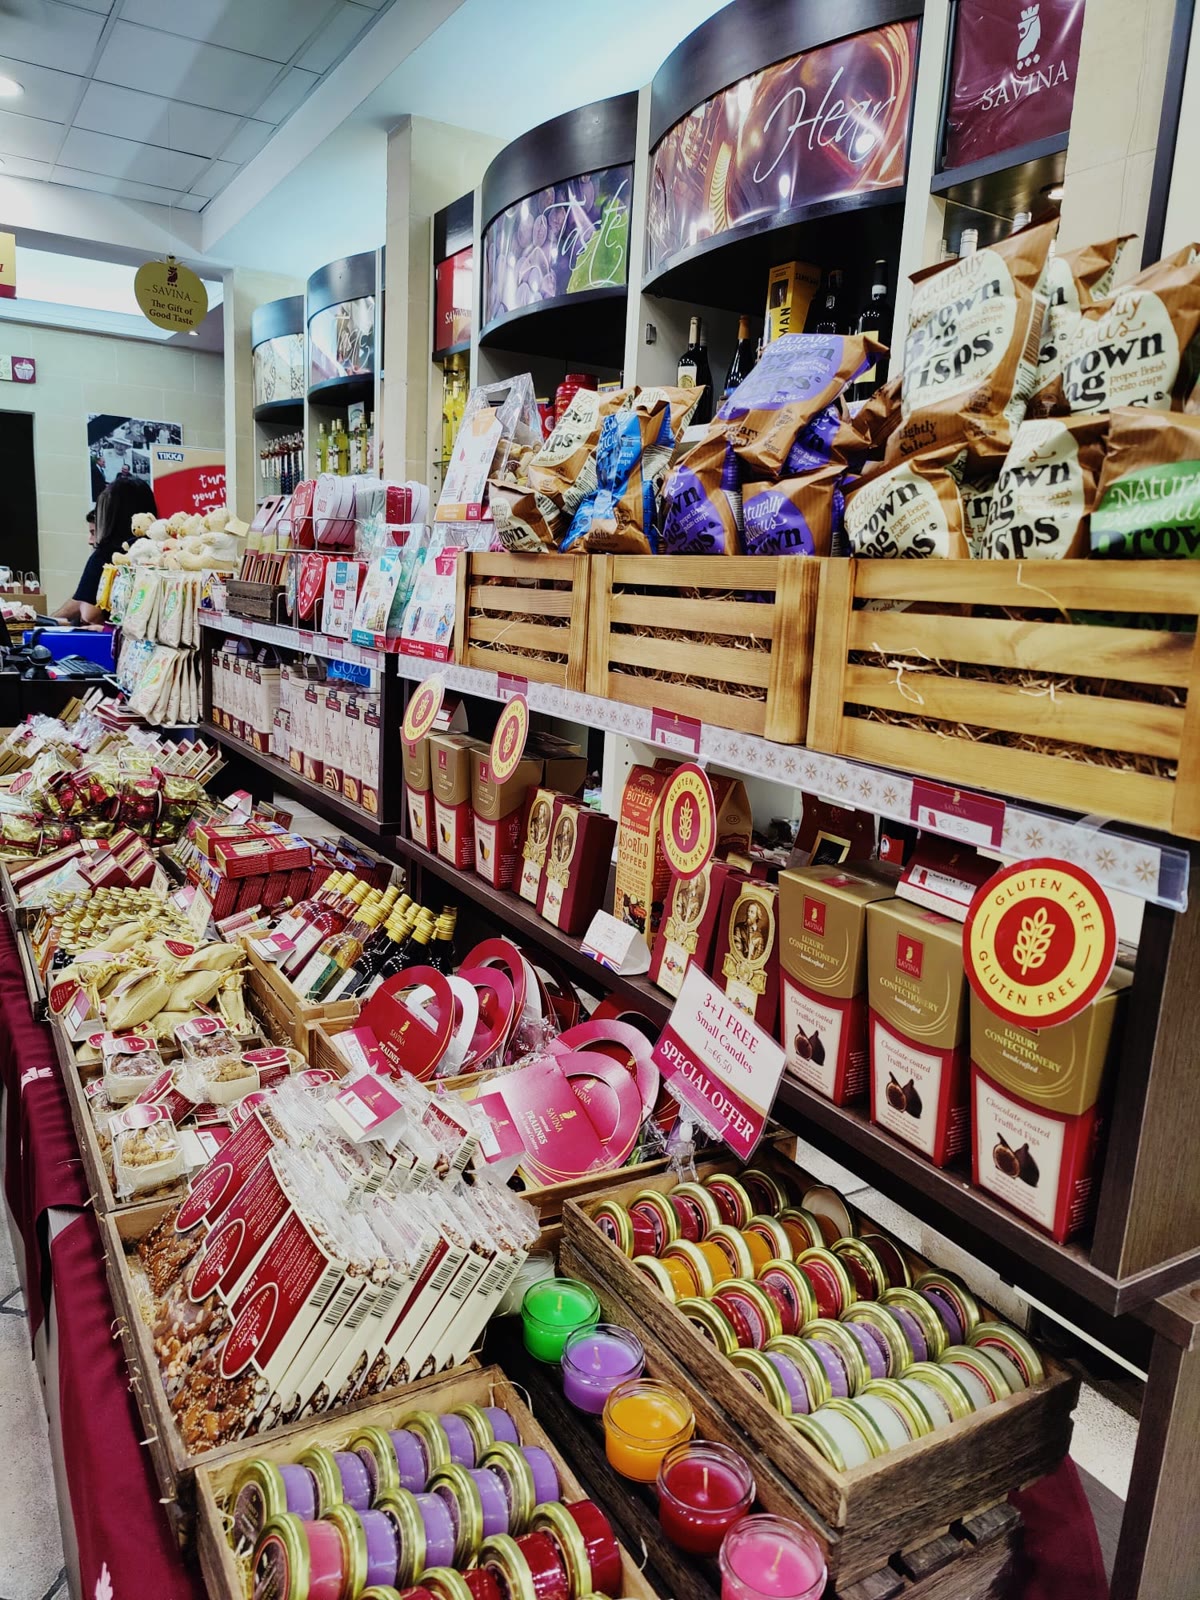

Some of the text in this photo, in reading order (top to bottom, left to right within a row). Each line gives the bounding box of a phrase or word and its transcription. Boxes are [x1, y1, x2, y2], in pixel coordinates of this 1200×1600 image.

[981, 60, 1069, 111] SAVINA
[753, 66, 896, 184] Hear
[542, 179, 628, 288] Taste
[152, 284, 191, 302] SAVINA
[149, 308, 194, 326] Good Taste
[151, 299, 193, 316] The Gift of
[1064, 332, 1166, 386] rown
[1110, 370, 1139, 386] proper
[192, 490, 217, 507] your
[855, 483, 923, 548] rown
[889, 515, 907, 534] proper
[626, 790, 654, 808] BUTLER
[669, 776, 707, 809] GLUTEN FREE
[619, 851, 648, 870] TOFFEES
[666, 833, 706, 868] GLUTEN FREE
[995, 876, 1095, 933] GLUTEN FREE
[804, 919, 823, 933] SAVINA
[788, 937, 840, 966] CONFECTIONERY
[801, 935, 825, 951] LUXURY
[897, 958, 920, 975] SAVINA
[979, 950, 1077, 1007] GLUTEN FREE
[879, 976, 939, 1013] CONFECTIONERY
[894, 975, 920, 994] LUXURY
[703, 993, 759, 1055] 3+1 FREE
[790, 995, 834, 1025] Chocolate-coated
[795, 1008, 827, 1033] Truffled Figs
[389, 1029, 406, 1047] SAVINA
[695, 1010, 754, 1074] Small Candles
[984, 1028, 1062, 1073] CONFECTIONERY
[1004, 1027, 1040, 1051] LUXURY
[379, 1041, 401, 1065] PRALINES
[881, 1039, 931, 1074] Chocolate-coated
[1001, 1049, 1039, 1074] handcrafted
[886, 1054, 923, 1081] Truffled Figs
[571, 1084, 592, 1105] SAVINA
[660, 1039, 755, 1143] SPECIAL OFFER
[525, 1109, 548, 1145] PRALINES
[546, 1107, 564, 1133] SAVINA
[985, 1095, 1052, 1140] Chocolate-coated
[992, 1112, 1041, 1148] Truffled Figs
[242, 1274, 259, 1299] 150g
[221, 1289, 272, 1362] BRITTLE NOUGAT
